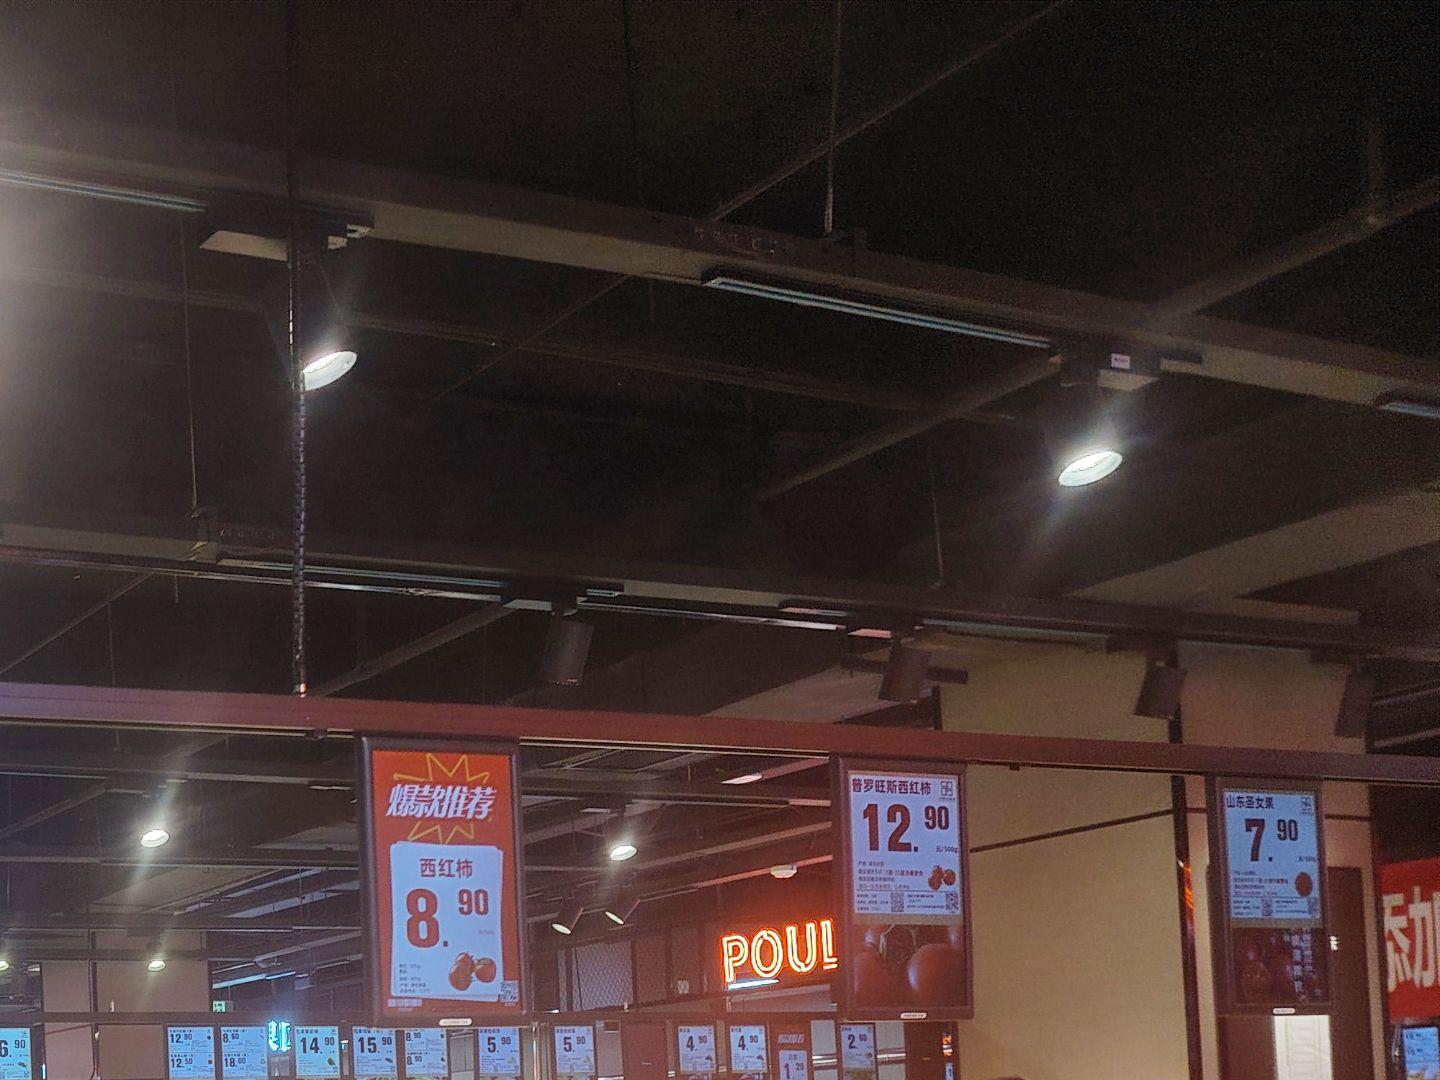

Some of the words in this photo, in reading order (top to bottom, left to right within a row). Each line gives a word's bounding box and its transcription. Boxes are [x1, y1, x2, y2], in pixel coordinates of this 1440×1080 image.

[852, 778, 931, 796] 普罗旺斯西红柿
[386, 784, 497, 819] 爆款推荐
[1226, 794, 1274, 810] 山东圣女果
[419, 858, 473, 878] 西红柿
[458, 888, 489, 916] 90
